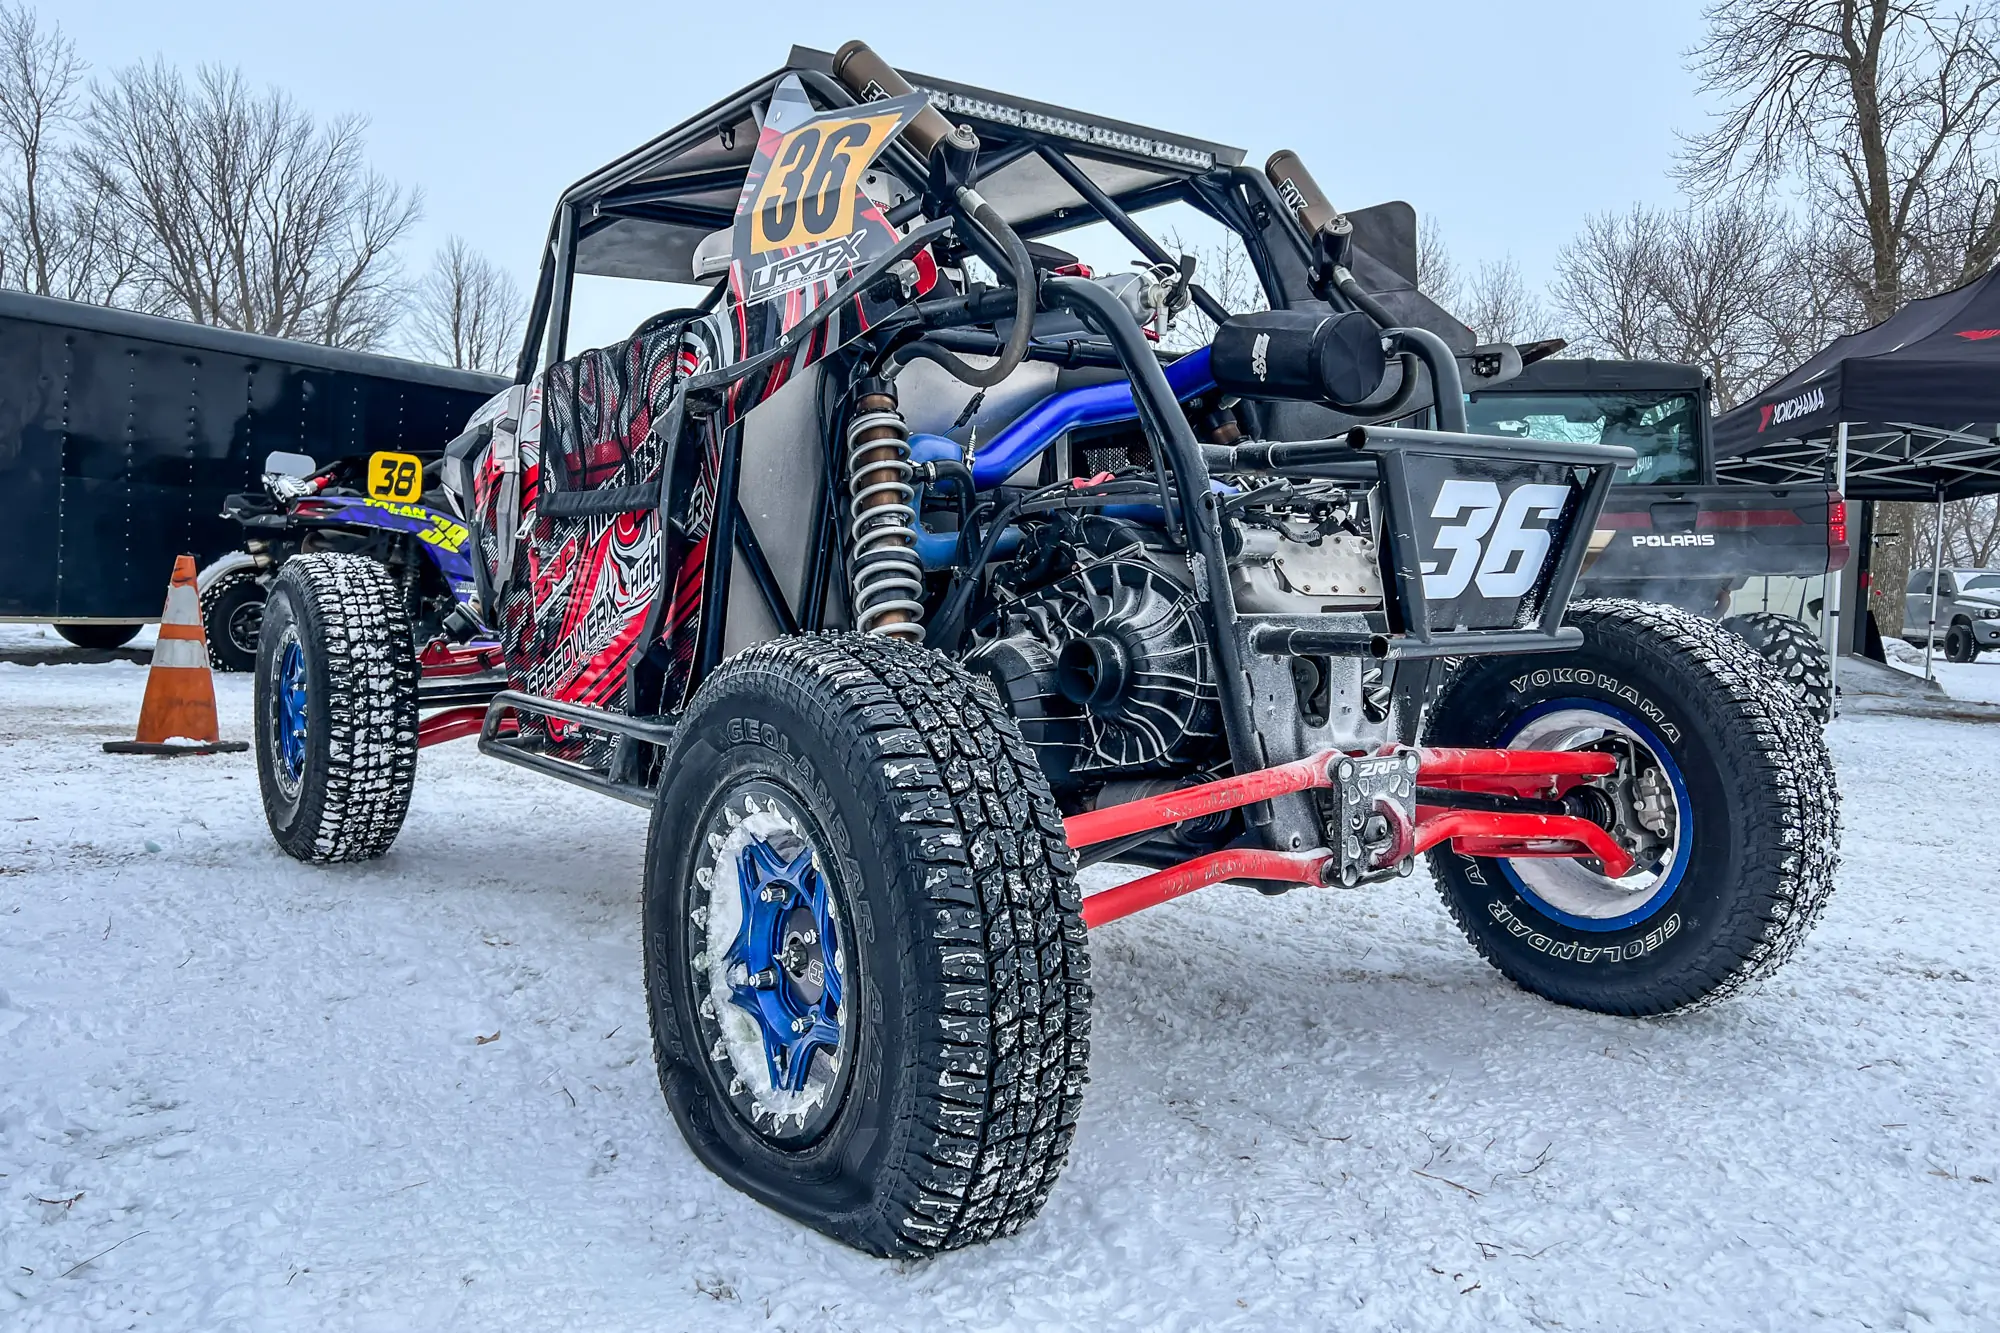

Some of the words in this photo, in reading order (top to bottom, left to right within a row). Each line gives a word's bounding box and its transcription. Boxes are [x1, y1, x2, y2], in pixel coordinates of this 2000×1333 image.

[762, 122, 871, 242] 36
[751, 229, 867, 293] UTVFX
[1773, 387, 1824, 425] YOKOHAMA
[375, 459, 416, 496] 38
[1420, 480, 1571, 599] 36
[1632, 535, 1715, 548] POLARIS
[528, 582, 620, 696] SPEEDWERX
[1510, 668, 1681, 744] YOKOHAMA
[1359, 761, 1400, 777] ZRP
[726, 717, 876, 945] GEOLANDAR
[1488, 899, 1681, 963] GEOLANDAR
